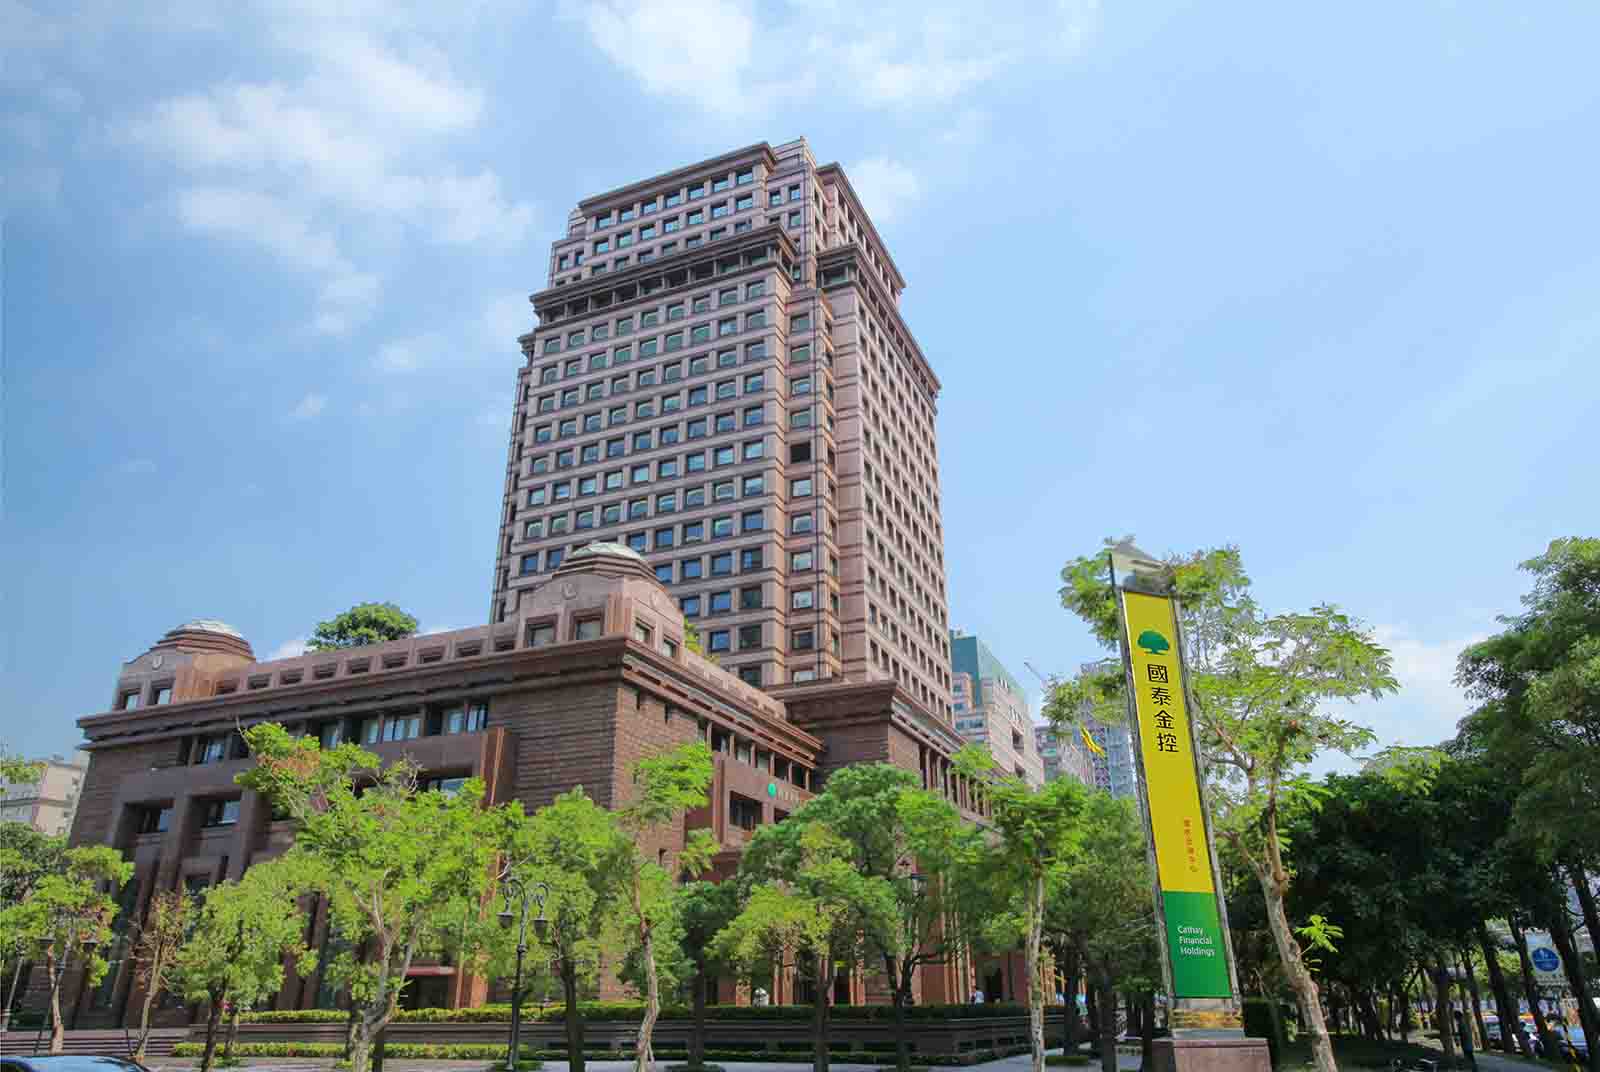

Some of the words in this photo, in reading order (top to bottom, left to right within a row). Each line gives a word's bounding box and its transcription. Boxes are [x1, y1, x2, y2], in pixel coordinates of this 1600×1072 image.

[1147, 663, 1179, 752] 國泰金控
[1177, 925, 1204, 936] Cathay
[1179, 935, 1212, 945] Financial
[1180, 946, 1215, 957] Holdings
